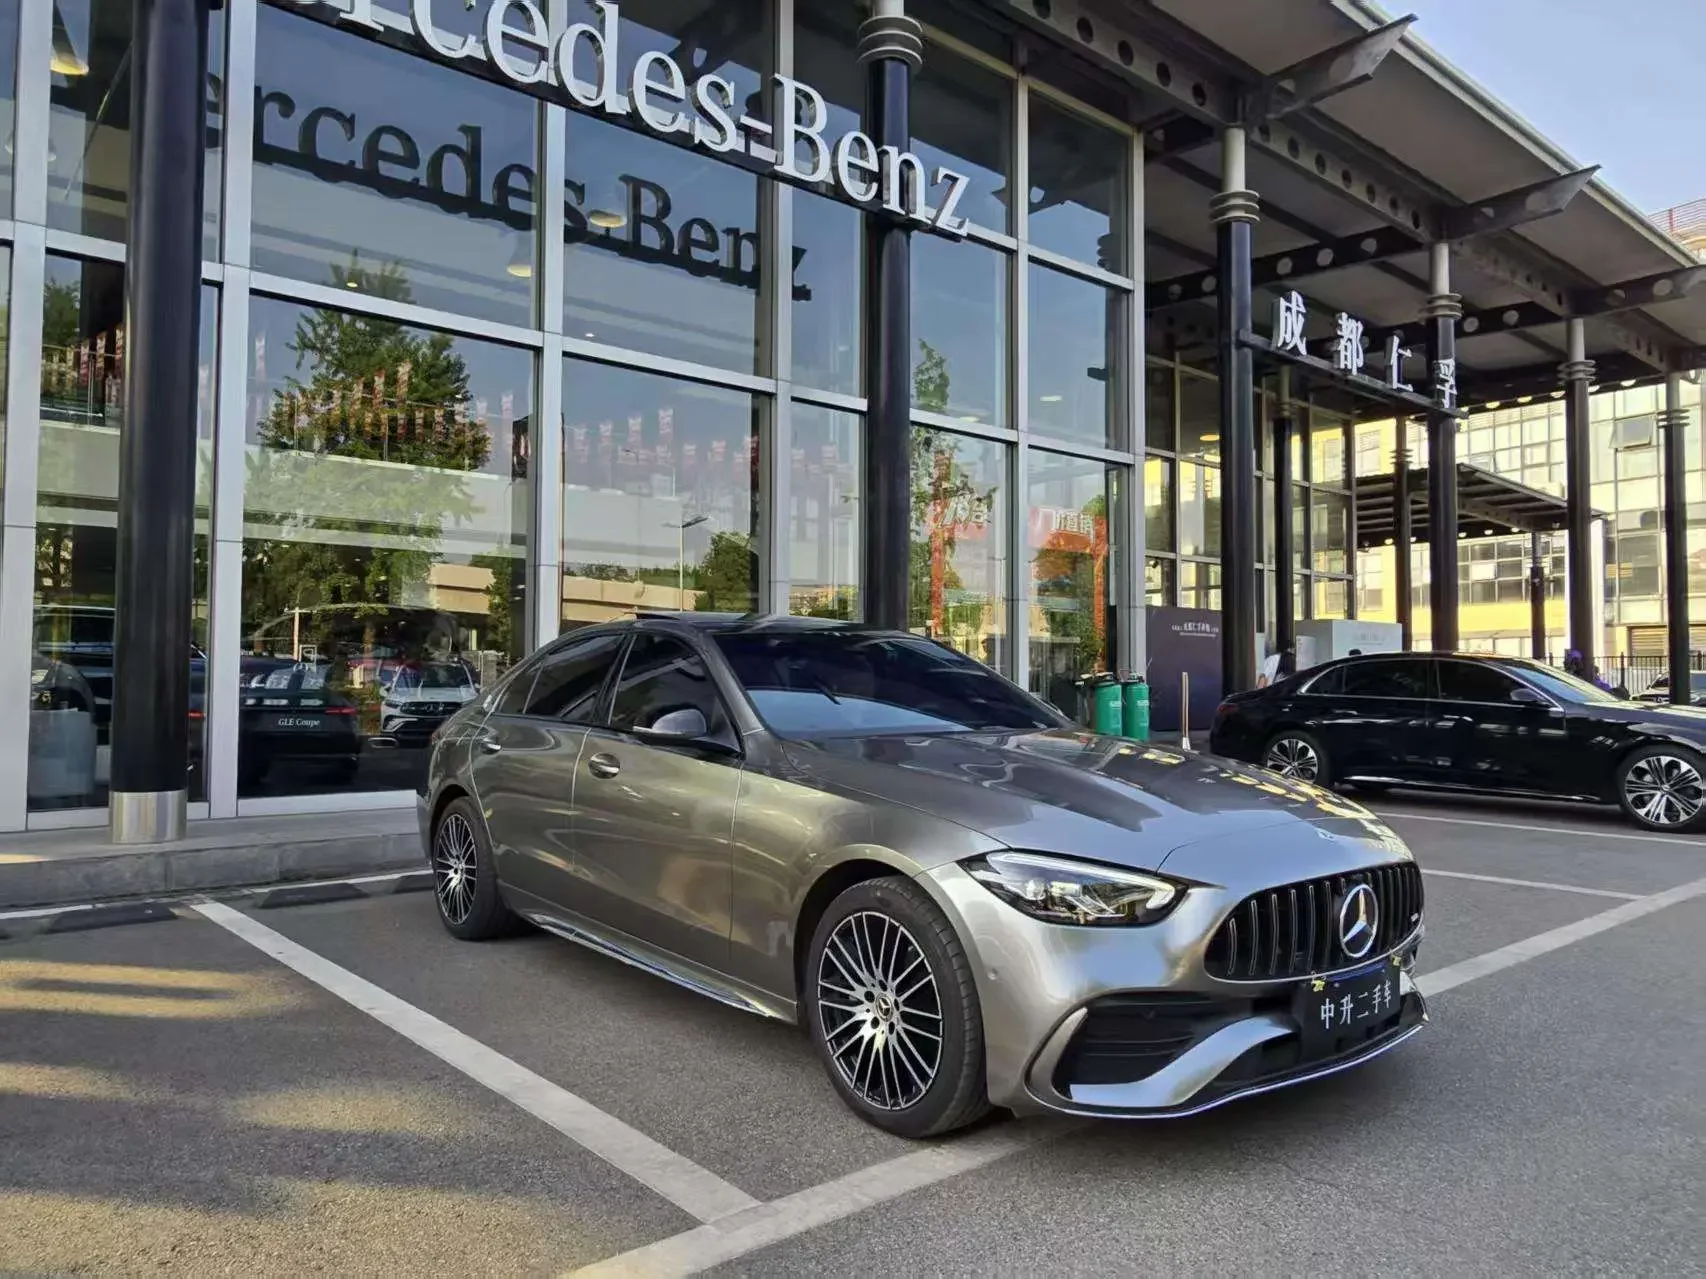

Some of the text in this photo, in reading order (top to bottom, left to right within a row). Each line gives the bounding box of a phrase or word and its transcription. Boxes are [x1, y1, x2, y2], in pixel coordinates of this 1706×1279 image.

[1277, 290, 1458, 409] 成都仁孚
[278, 718, 320, 728] GLE Coupe
[1320, 980, 1392, 1029] 中升二手车
